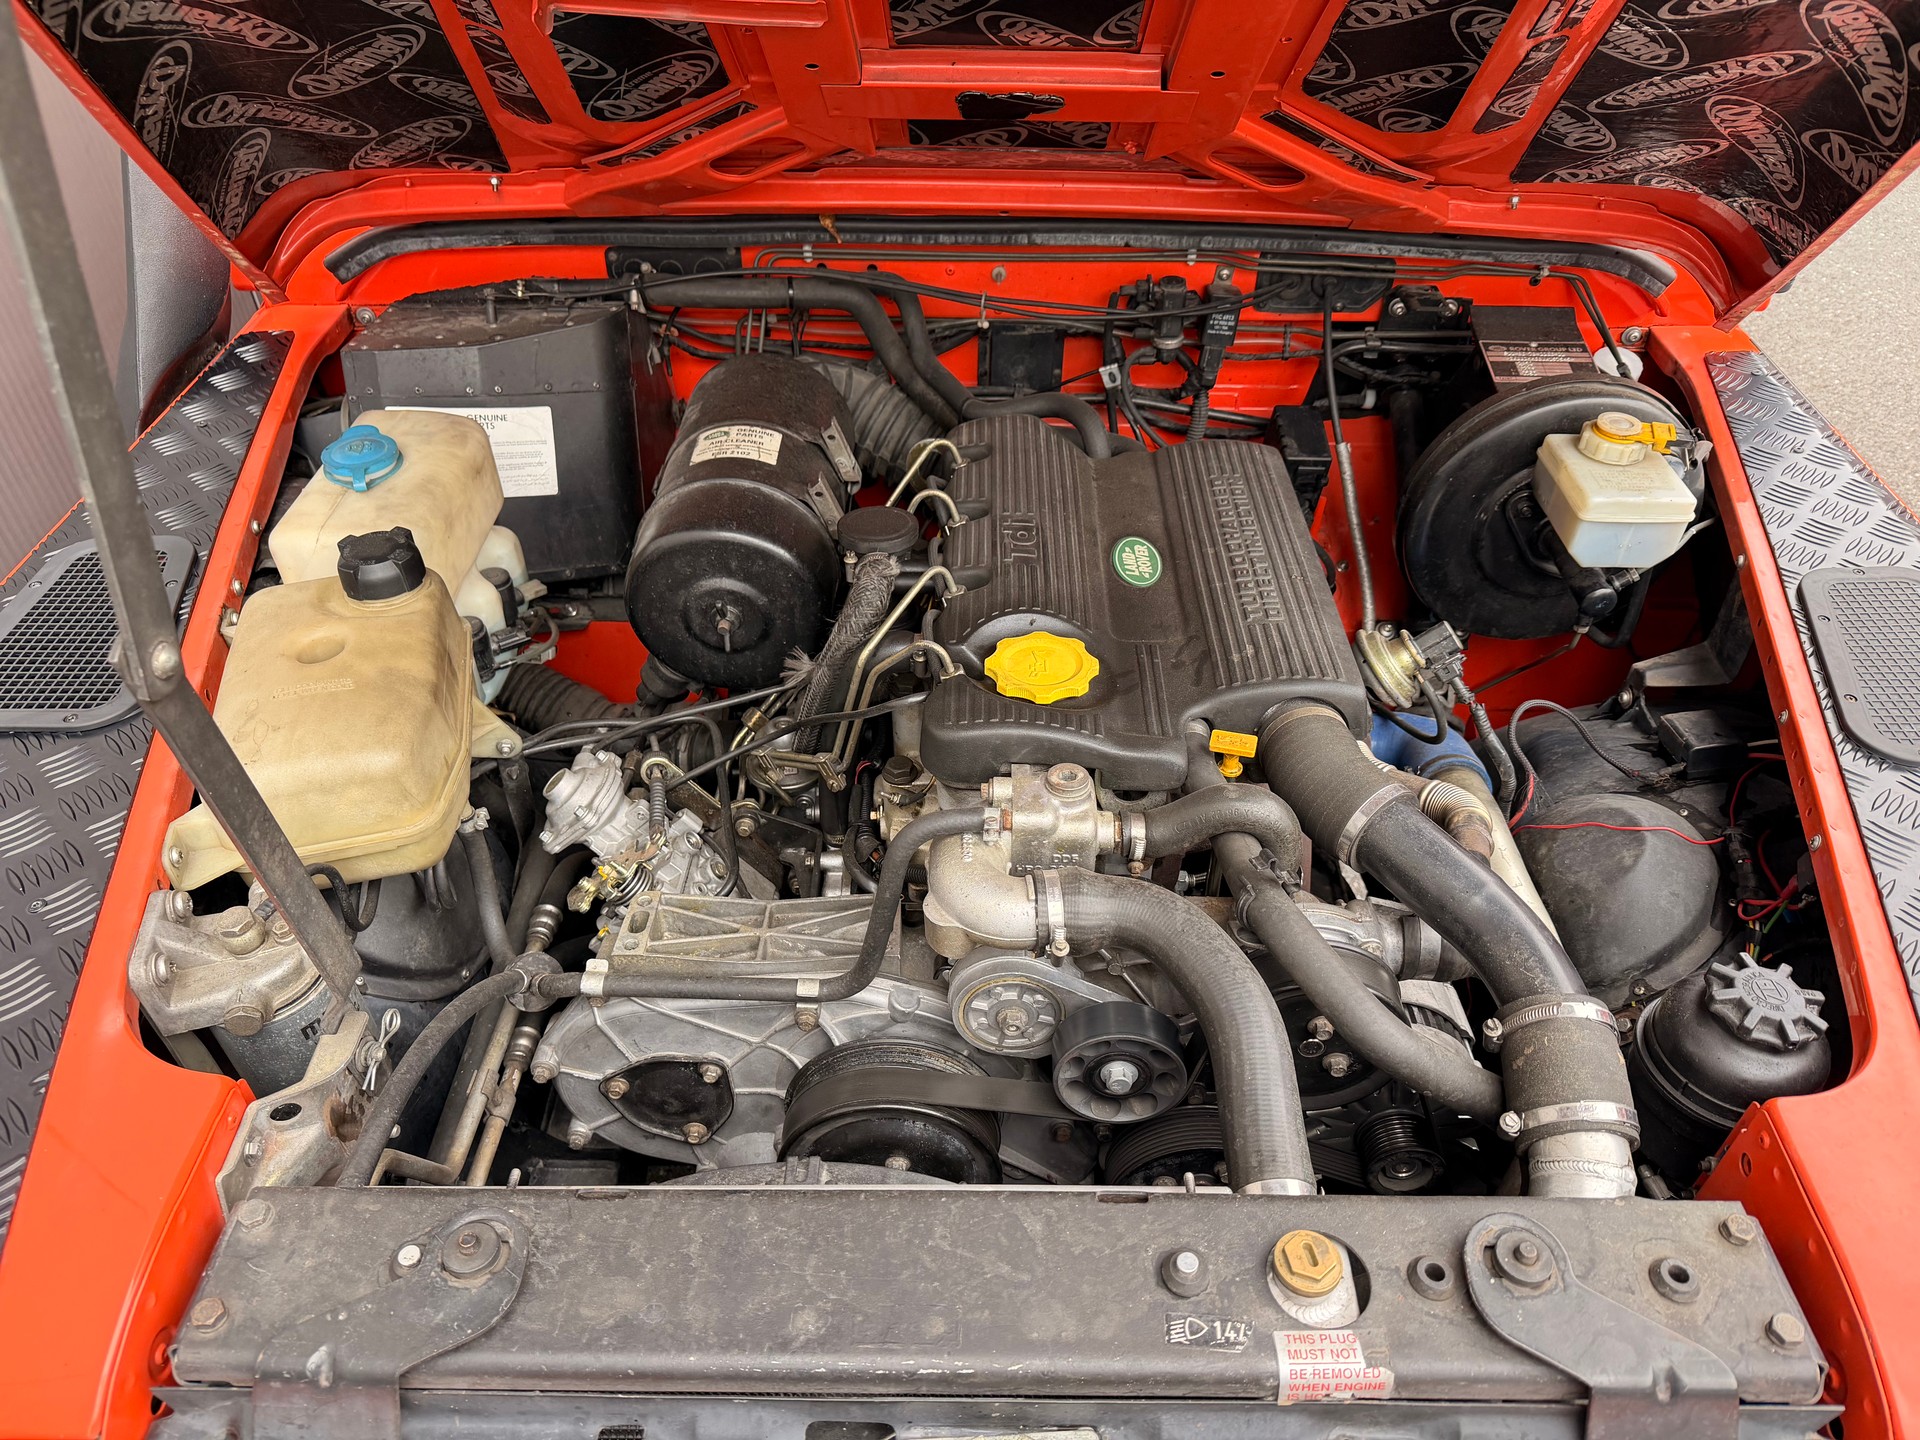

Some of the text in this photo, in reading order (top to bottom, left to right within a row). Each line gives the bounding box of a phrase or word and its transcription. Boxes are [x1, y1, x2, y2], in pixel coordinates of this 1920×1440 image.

[296, 33, 412, 91] Dynamat
[594, 59, 706, 117] Dynamat
[1612, 56, 1788, 108] Dynamat
[206, 94, 357, 135] Dynamat
[1711, 103, 1798, 192] Dynamat
[481, 422, 495, 430] RTS
[736, 432, 764, 440] PARTS
[737, 428, 775, 438] GENUINE
[708, 438, 764, 447] AIR CLEANER
[1001, 518, 1038, 562] Tdi
[1210, 478, 1263, 622] TURBOCHARGER
[1228, 478, 1285, 621] DIRECT INJECTION
[1121, 552, 1140, 576] LAND
[1133, 544, 1153, 573] ROVER
[1284, 1333, 1358, 1345] THIS PLUG
[1287, 1348, 1358, 1361] MUST NOT
[1289, 1367, 1381, 1381] BE REMOVED
[1287, 1393, 1325, 1401] IS HO
[1288, 1381, 1386, 1392] WHEN ENGINE
